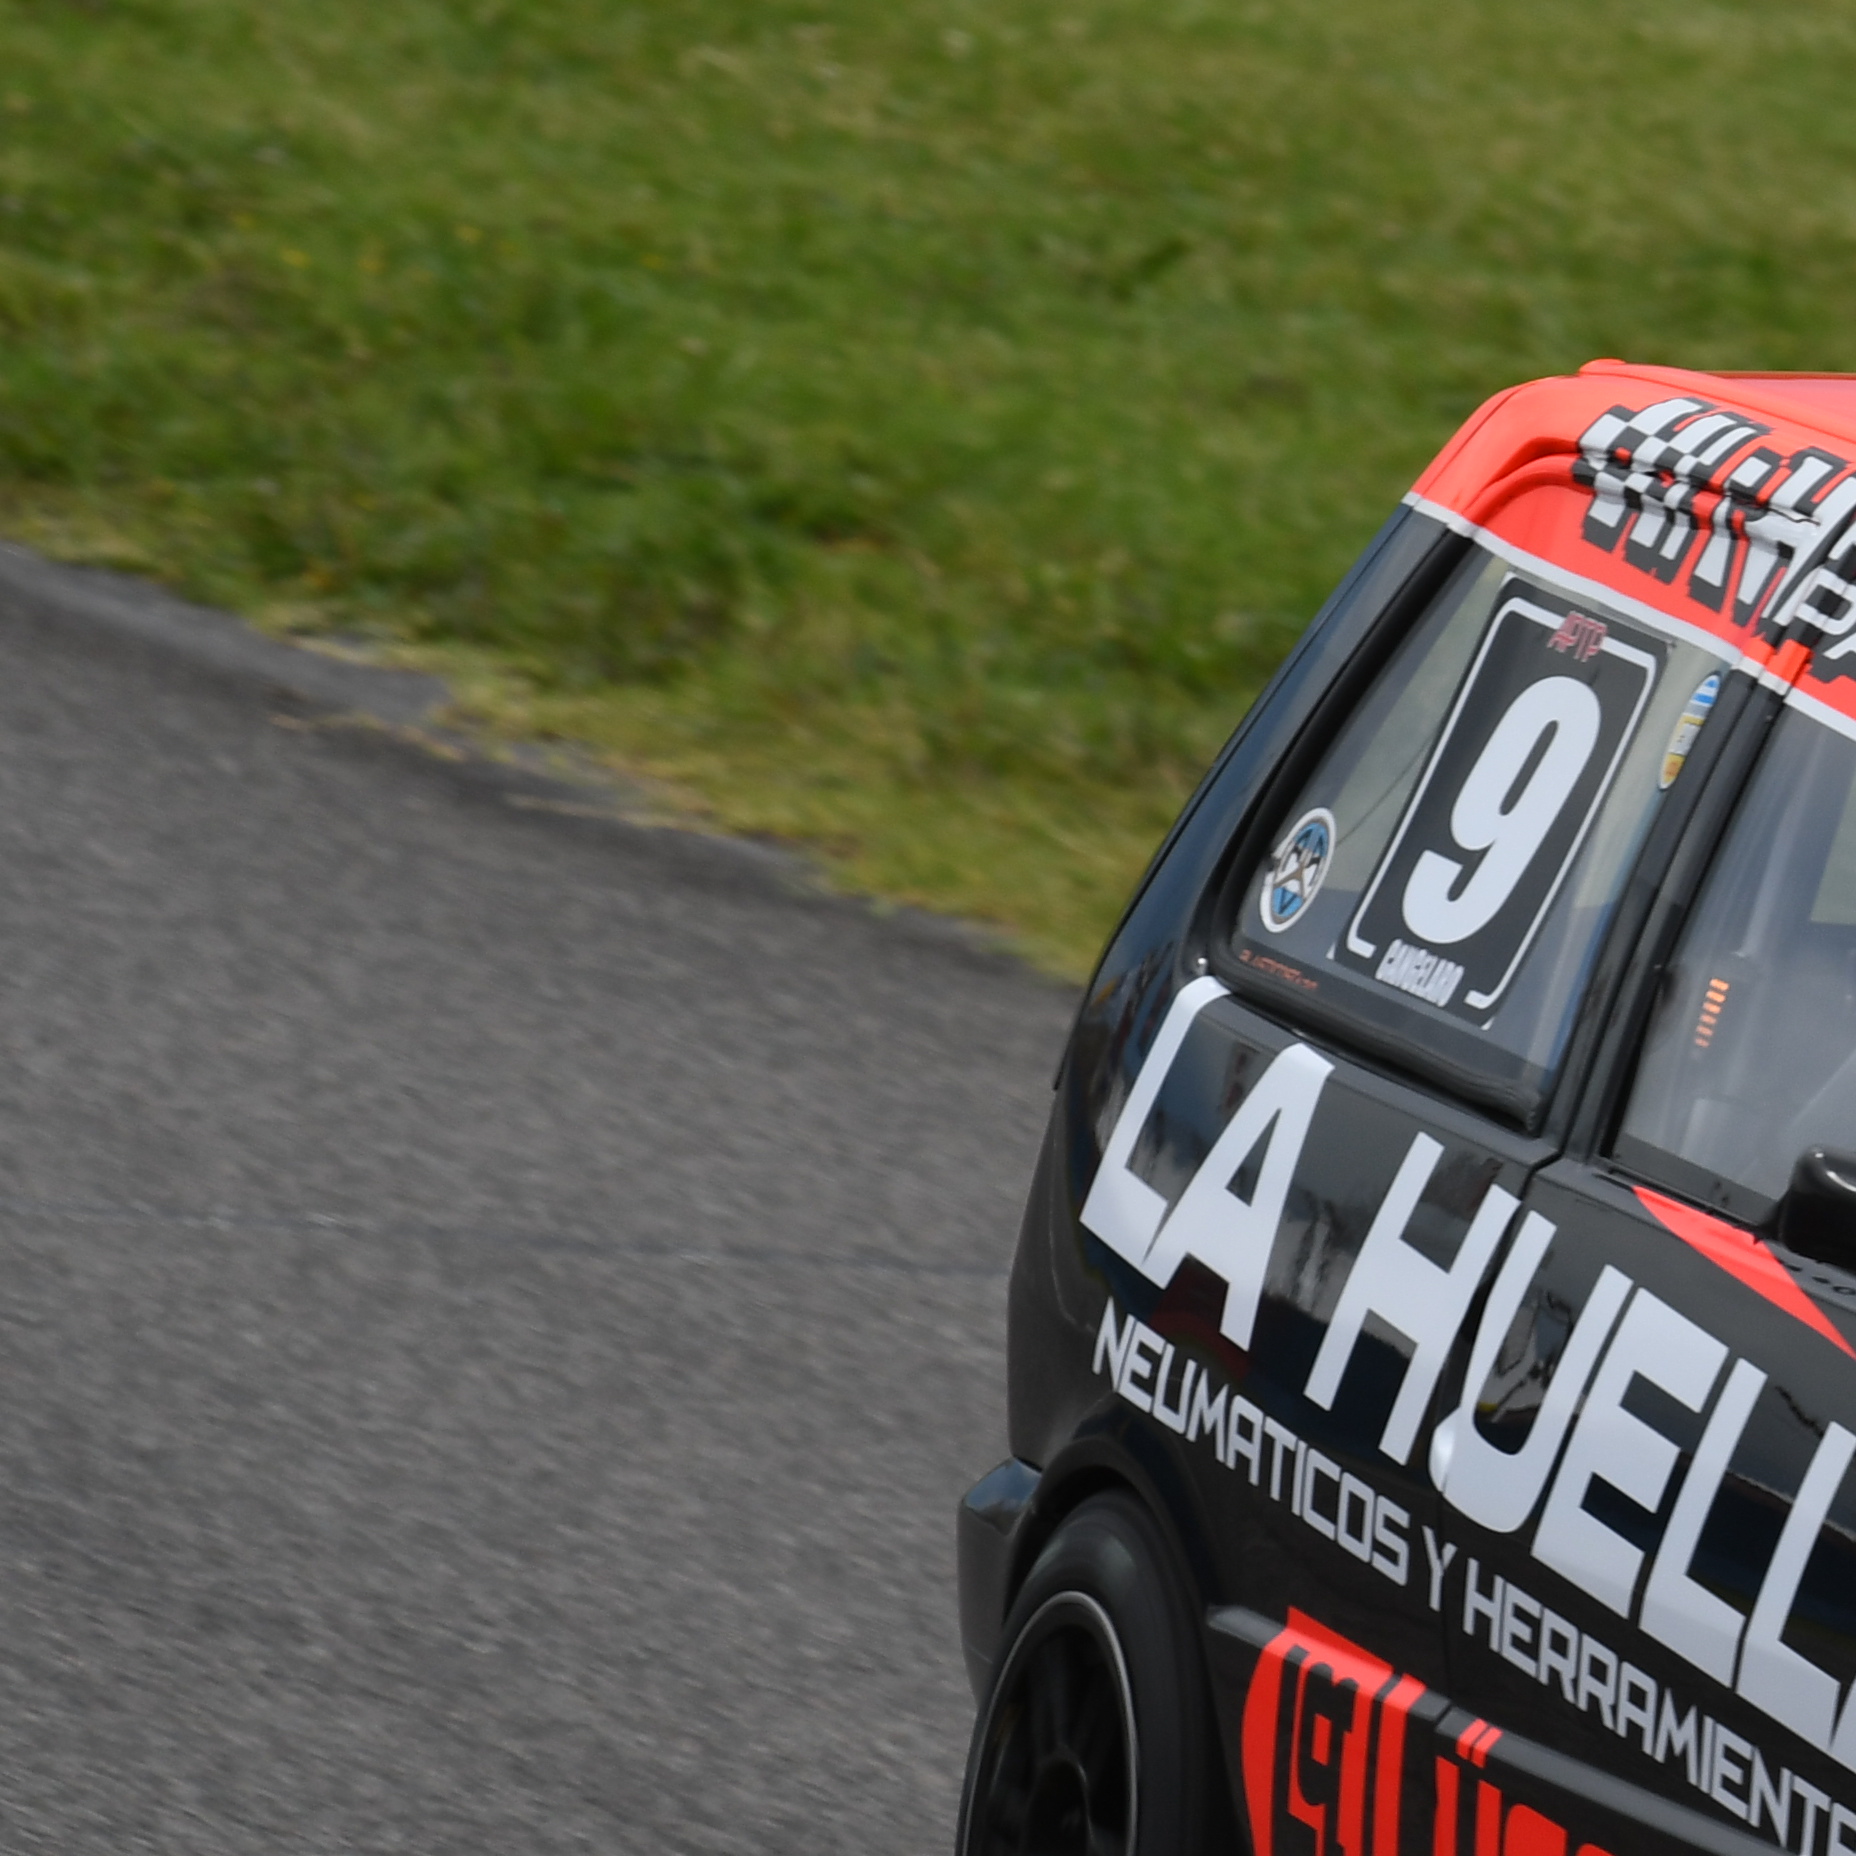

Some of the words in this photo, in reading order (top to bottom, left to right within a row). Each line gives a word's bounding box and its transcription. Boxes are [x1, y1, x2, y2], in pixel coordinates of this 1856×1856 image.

[1402, 675, 1602, 944] 9
[1078, 975, 1336, 1352] LA
[1092, 1298, 1409, 1588] NEUMATICOS
[1422, 1525, 1458, 1612] Y
